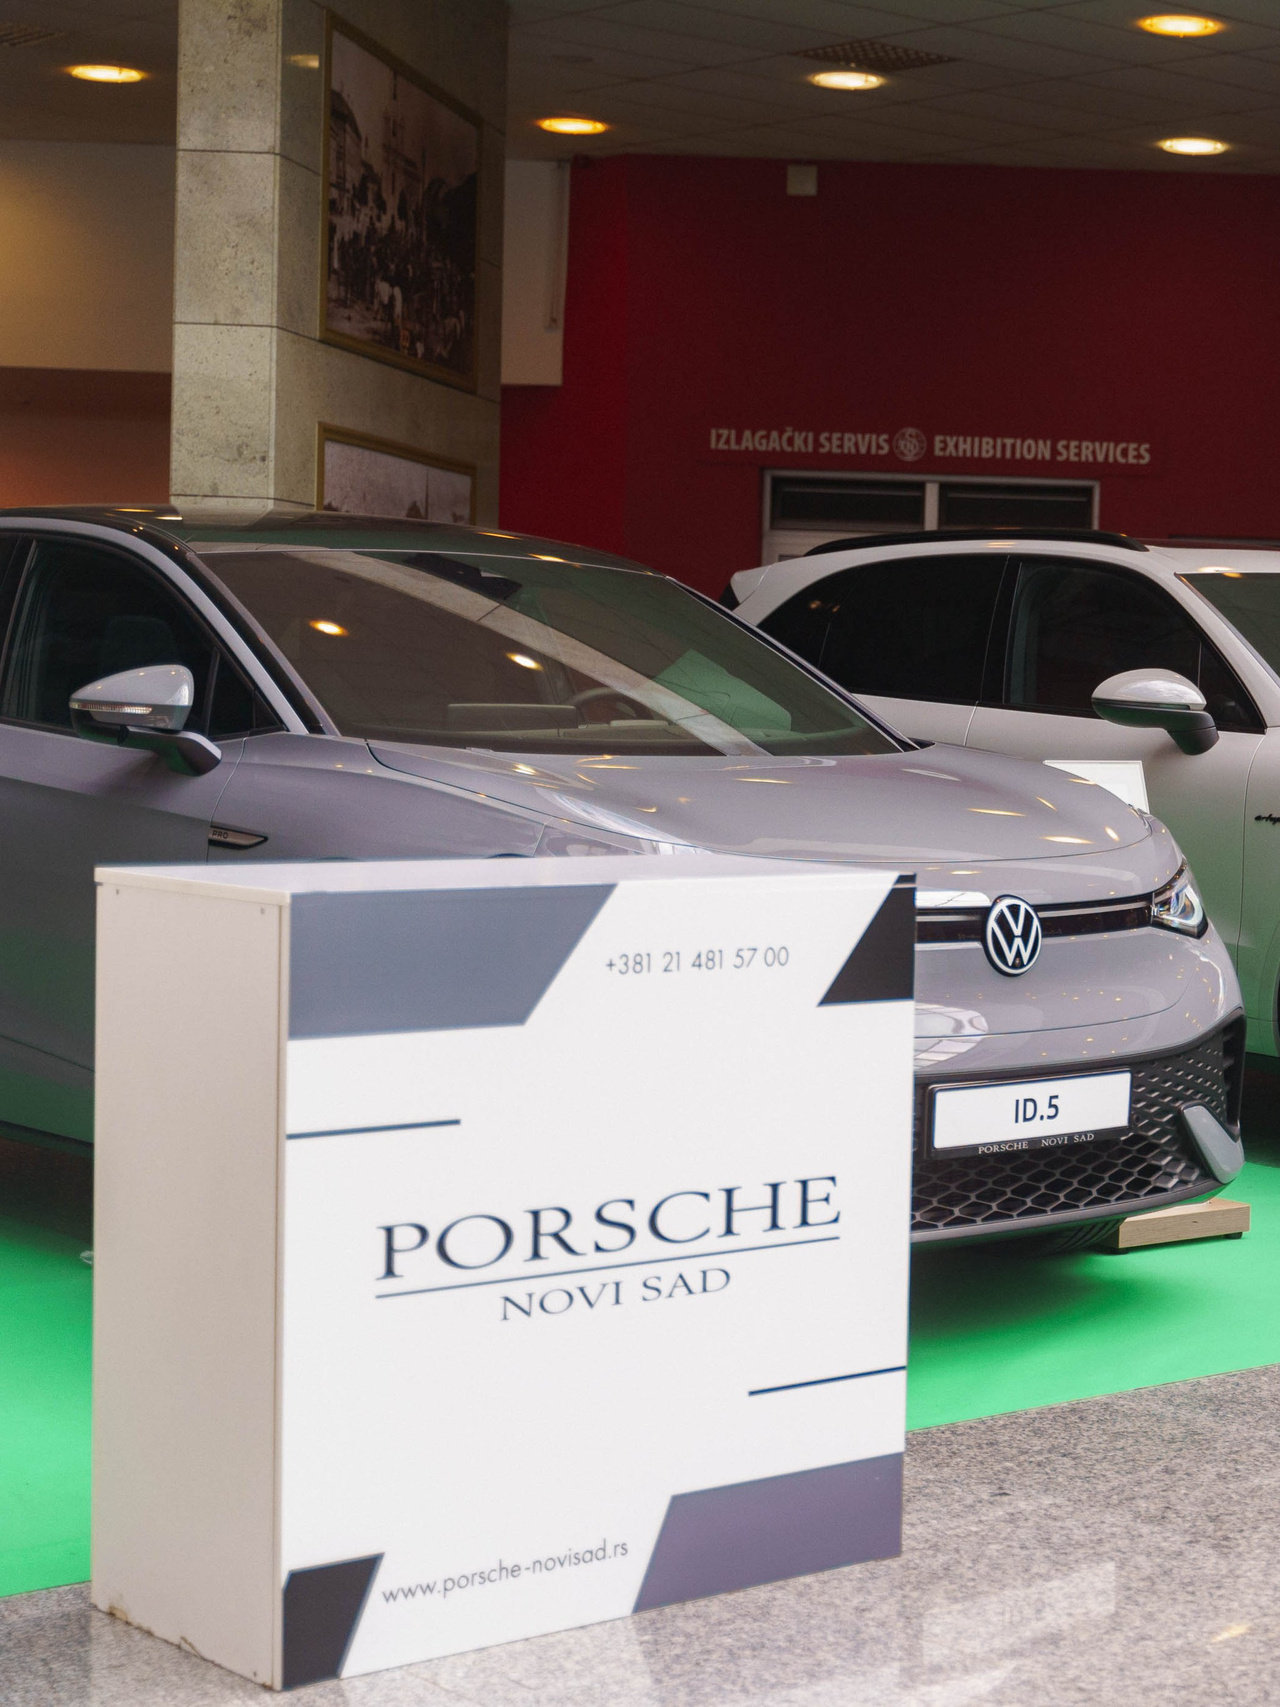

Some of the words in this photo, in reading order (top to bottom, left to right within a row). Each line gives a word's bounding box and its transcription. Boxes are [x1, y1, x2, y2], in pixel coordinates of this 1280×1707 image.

[710, 427, 814, 453] IZLAGAČKI
[819, 431, 889, 455] SERVIS
[934, 435, 1051, 460] EXHIBITION
[1056, 440, 1151, 465] SERVICES
[211, 829, 229, 839] PRO
[606, 952, 651, 976] +381
[663, 950, 681, 973] 21
[691, 948, 724, 971] 481
[733, 947, 759, 969] 57
[764, 946, 789, 968] 00
[1014, 1095, 1060, 1124] ID.5
[978, 1140, 1029, 1155] PORSCHE
[1041, 1135, 1069, 1147] NOVI
[1073, 1132, 1095, 1143] SAD
[376, 1175, 842, 1281] PORSCHE
[500, 1282, 624, 1322] NOVI
[642, 1267, 731, 1302] SAD
[382, 1538, 629, 1604] www.porsche-novisad.rs
